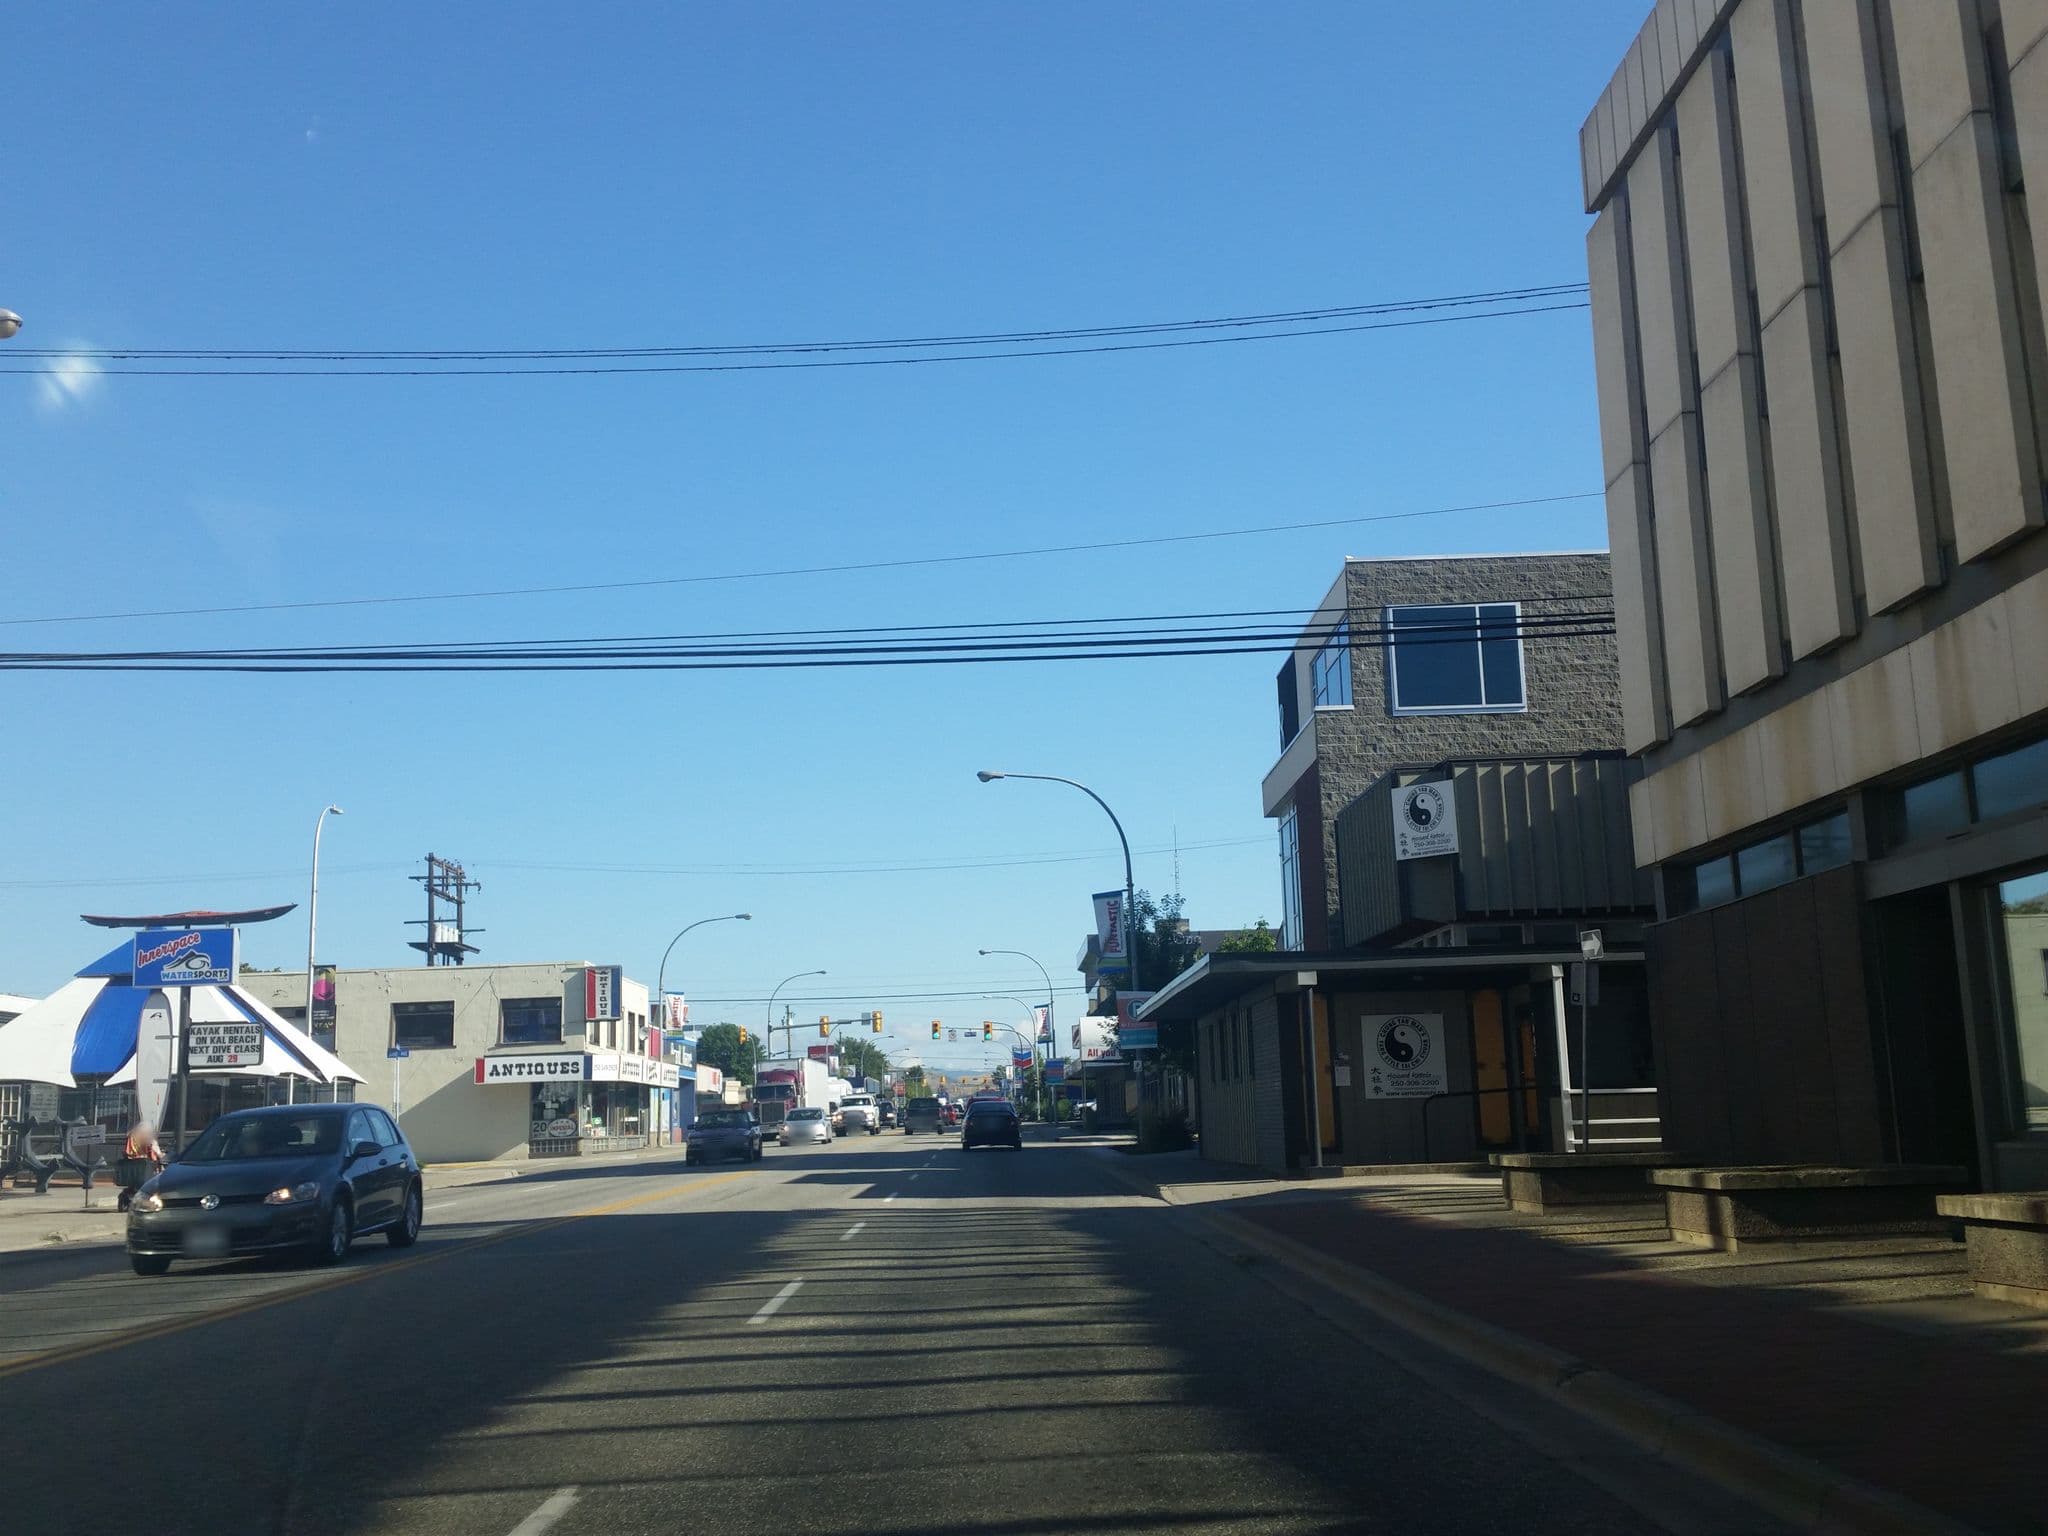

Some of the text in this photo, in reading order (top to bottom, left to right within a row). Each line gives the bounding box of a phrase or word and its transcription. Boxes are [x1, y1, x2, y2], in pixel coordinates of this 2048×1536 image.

[1107, 900, 1122, 953] FUNTASTIC
[137, 932, 201, 967] Innerspace
[162, 969, 228, 980] WATERSPORTS
[599, 970, 609, 1016] ANTIQUE
[190, 1025, 261, 1036] KAYAK RENTALS
[195, 1035, 257, 1045] ON KAL BEACH
[212, 1045, 232, 1054] DIVE
[234, 1044, 261, 1053] CLASS
[1087, 1048, 1099, 1057] All
[206, 1054, 238, 1063] AUG 29
[489, 1061, 580, 1077] ANTIQUES
